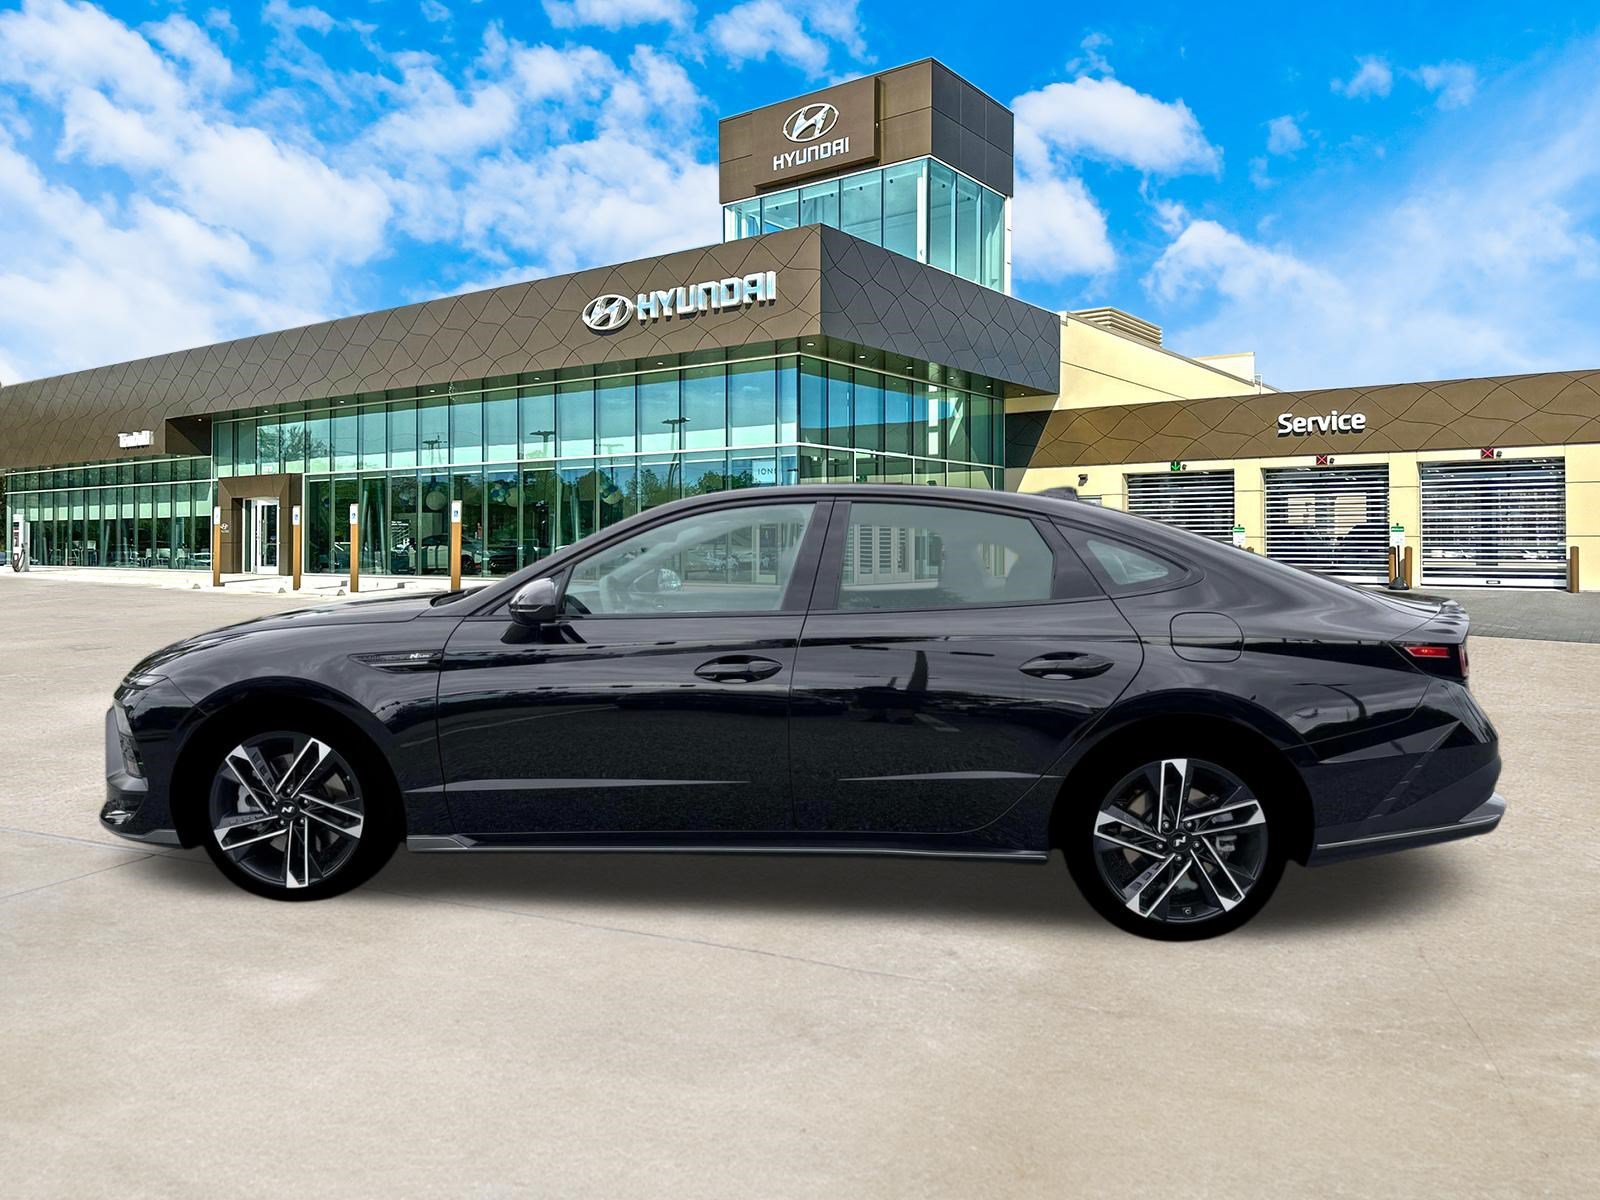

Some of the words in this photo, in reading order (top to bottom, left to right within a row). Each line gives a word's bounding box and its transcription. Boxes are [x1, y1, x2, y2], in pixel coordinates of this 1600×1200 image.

[773, 136, 849, 171] HYUNDAI
[637, 270, 776, 321] HYUNDAI
[1278, 410, 1366, 434] Service
